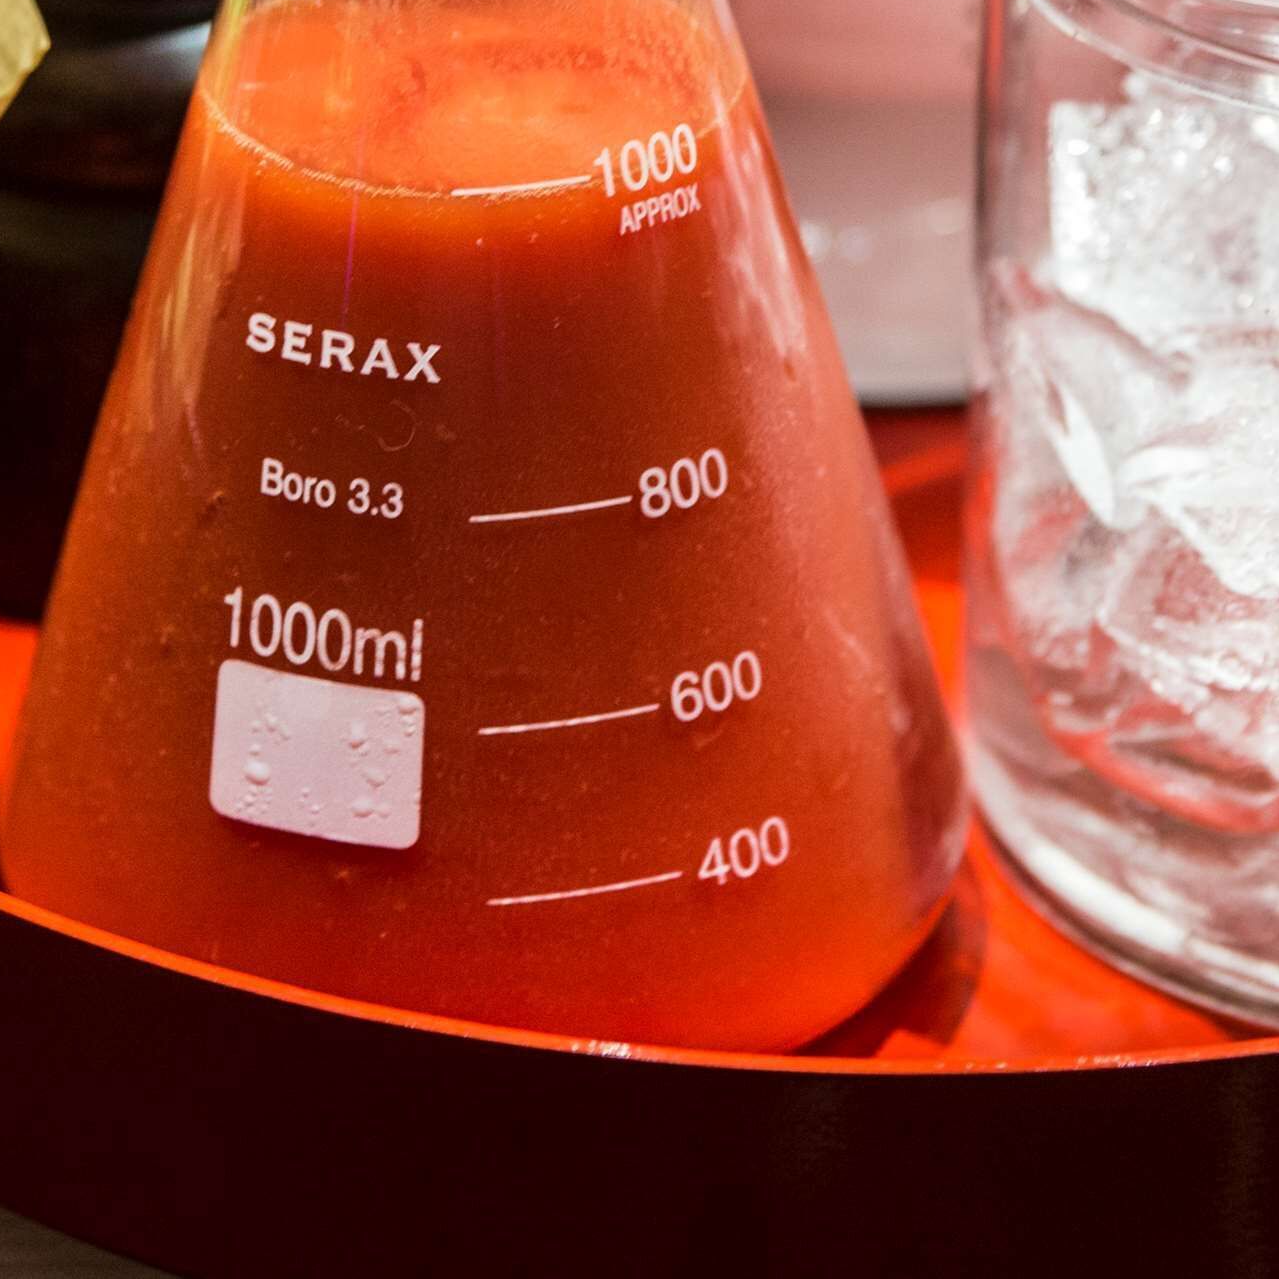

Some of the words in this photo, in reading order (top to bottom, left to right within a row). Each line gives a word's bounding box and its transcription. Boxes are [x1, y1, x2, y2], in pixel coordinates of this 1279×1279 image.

[592, 122, 699, 199] 1000
[619, 182, 703, 237] APPROX
[245, 312, 442, 385] SERAX
[259, 456, 337, 510] Boro
[346, 477, 405, 520] 3.3
[638, 447, 730, 520] 800
[222, 586, 424, 682] 1000ml
[669, 650, 764, 722] 600
[696, 814, 792, 886] 400
